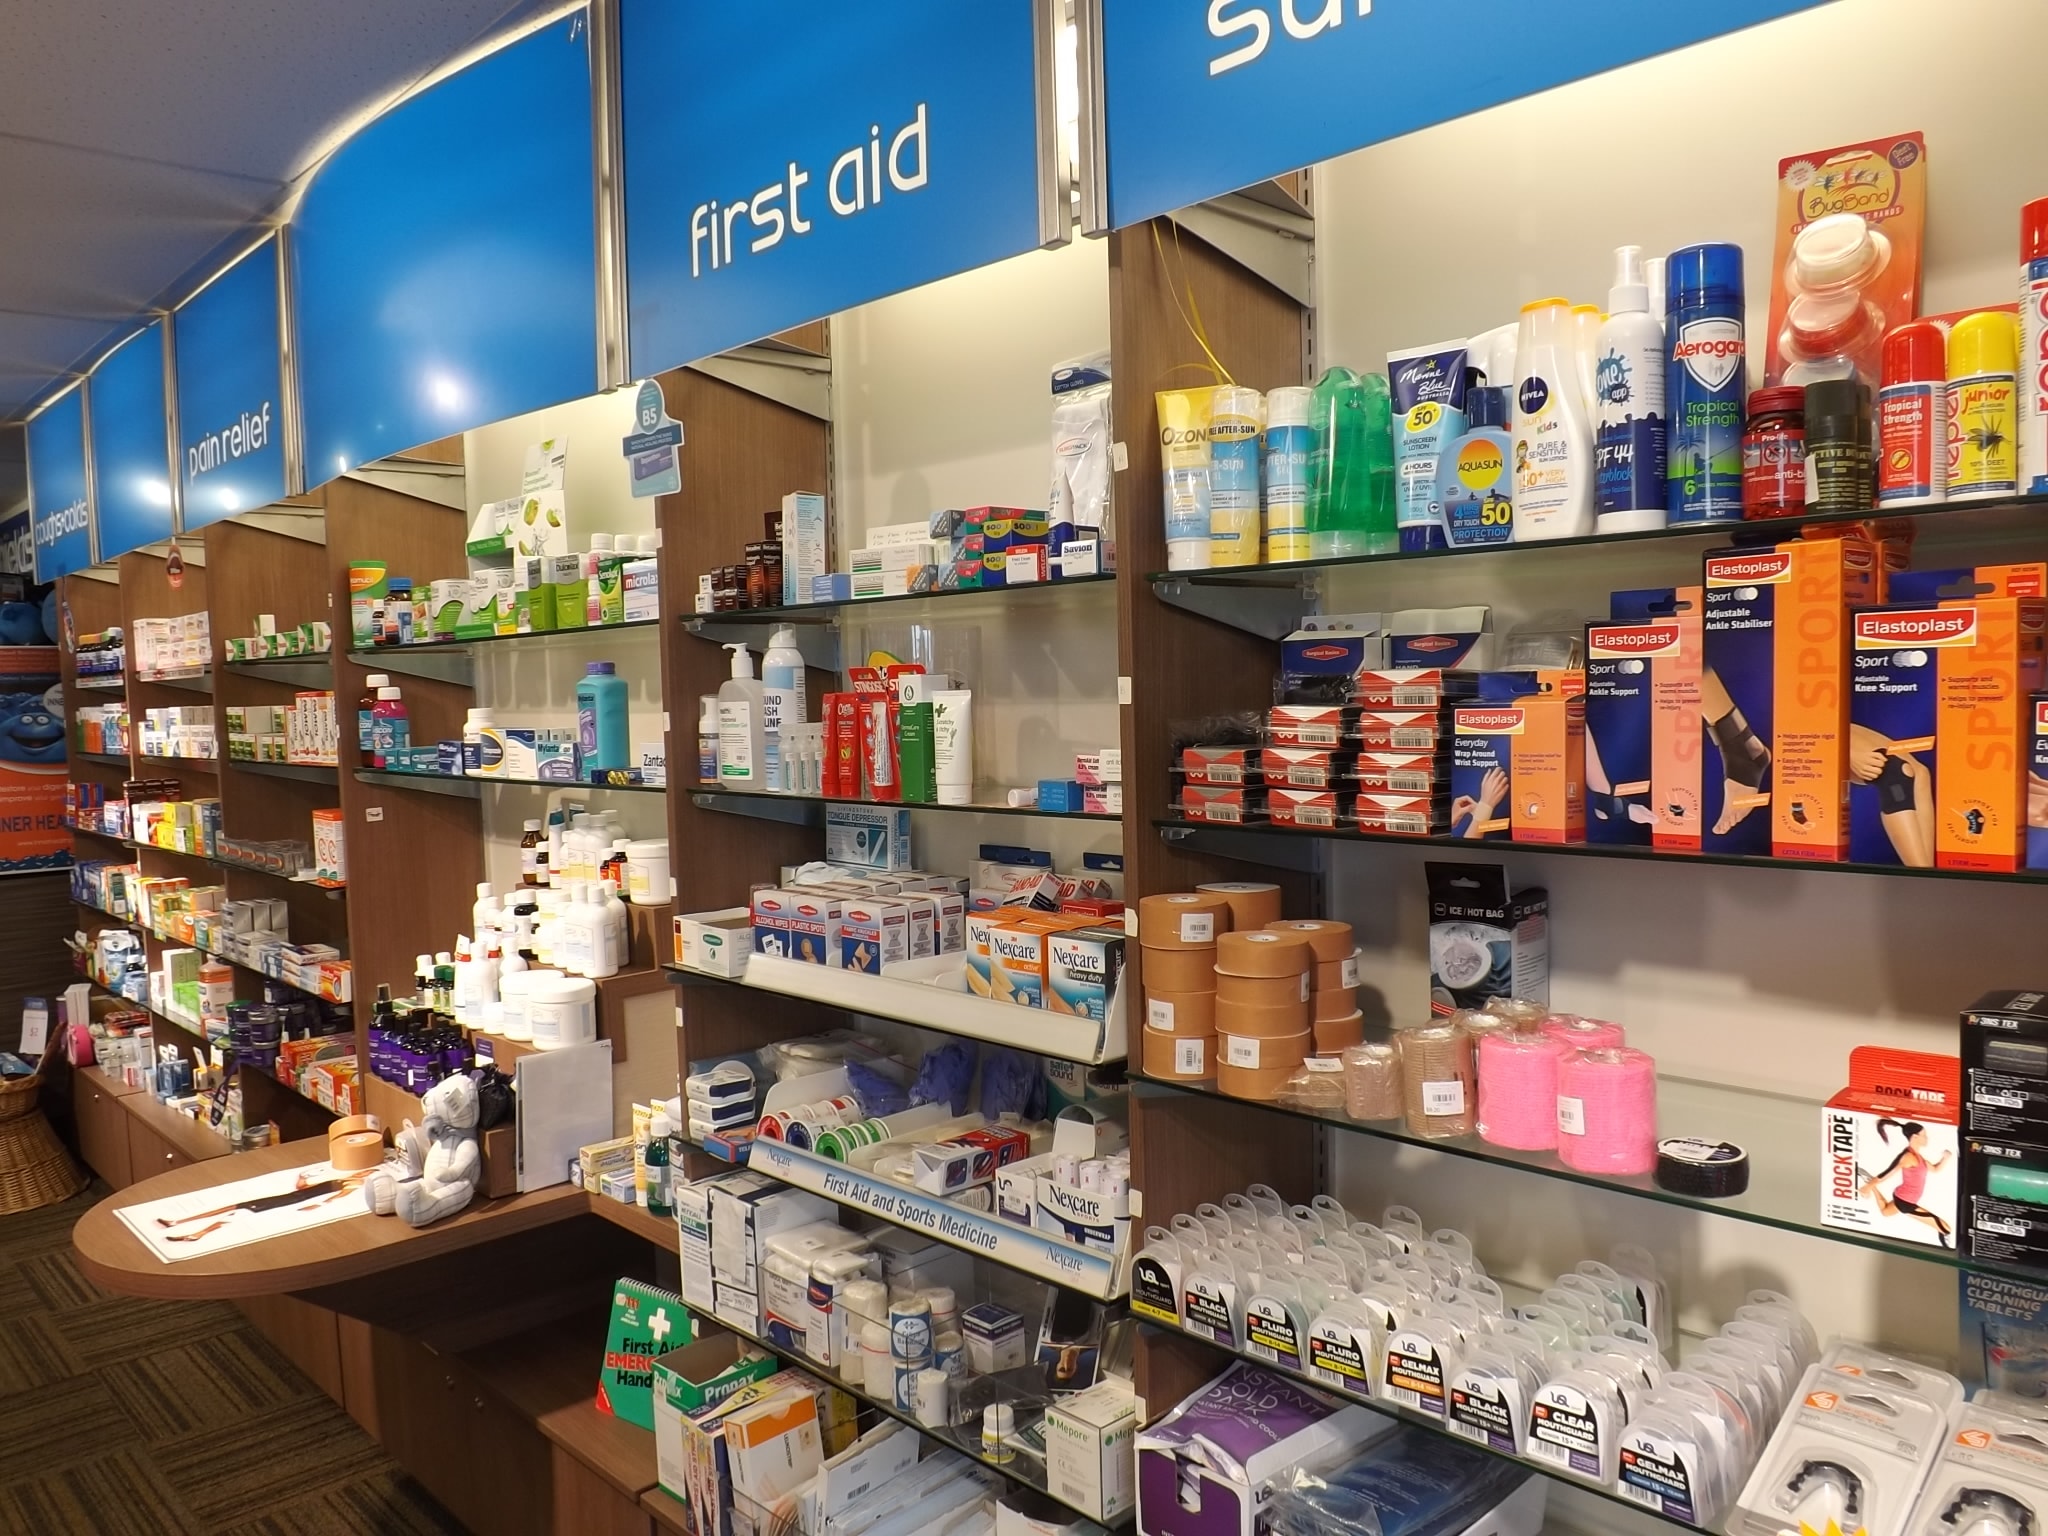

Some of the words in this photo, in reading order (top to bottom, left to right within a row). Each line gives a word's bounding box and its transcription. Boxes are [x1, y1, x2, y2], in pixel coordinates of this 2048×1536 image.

[690, 161, 811, 278] first
[828, 102, 929, 215] aid
[1400, 368, 1443, 383] Marine
[1418, 380, 1446, 394] Blue
[1611, 385, 1627, 399] app
[1417, 391, 1451, 401] AUSTRALIA
[1521, 390, 1545, 402] NIVEA
[1961, 384, 2010, 415] junior
[1687, 400, 1739, 414] Tropical
[1884, 398, 1922, 413] Tropical
[642, 408, 658, 426] B5
[1522, 416, 1542, 427] sun
[1686, 414, 1739, 427] Strength
[1883, 411, 1922, 426] Strength
[1217, 425, 1256, 435] AFTER-SUN
[1536, 422, 1558, 435] Kids
[189, 434, 220, 487] pain
[222, 400, 271, 462] relief
[1403, 437, 1437, 446] SUNSCREEN
[1408, 443, 1429, 451] LOTION
[1537, 441, 1558, 450] PURE
[1561, 439, 1567, 448] &
[1528, 448, 1567, 459] SENSITIVE
[1614, 444, 1634, 464] 44
[1411, 462, 1433, 470] HOURS
[1457, 459, 1503, 472] AQUASUN
[1987, 459, 2005, 467] DEET
[1544, 469, 1565, 477] VERY
[1545, 476, 1566, 485] HIGH
[1684, 479, 1697, 496] 6
[1454, 506, 1464, 519] 4
[1481, 502, 1511, 526] 50
[1453, 519, 1464, 527] DRY
[1464, 517, 1480, 526] TOUCH
[1453, 527, 1509, 539] PROTECTION
[1711, 560, 1783, 576] Elastoplast
[1706, 592, 1732, 604] Sport
[1705, 608, 1751, 619] Adjustable
[1705, 620, 1730, 630] Ankle
[1731, 619, 1773, 630] Stabiliser
[1797, 545, 1839, 709] SPORT
[1862, 618, 1965, 635] Elastoplast
[1595, 633, 1672, 647] Elastoplast
[1855, 656, 1889, 668] Sport
[1589, 664, 1616, 675] Sport
[1855, 675, 1890, 683] Adjustable
[1589, 687, 1609, 696] Ankle
[1610, 687, 1639, 697] Support
[1855, 684, 1877, 692] Knee
[1879, 683, 1918, 694] Support
[1458, 714, 1518, 726] Elastoplast
[1455, 738, 1489, 749] Everyday
[1454, 750, 1470, 760] Wrap
[1471, 750, 1495, 758] Around
[1454, 759, 1471, 767] Wrist
[1472, 759, 1498, 768] Support
[827, 811, 851, 821] TONGUE
[851, 813, 888, 824] DEPRESSOR
[1057, 882, 1076, 898] AID
[1449, 906, 1463, 916] ICE
[1467, 908, 1484, 918] HOT
[1485, 909, 1505, 919] BAG
[754, 916, 775, 926] ALCOHOL
[775, 919, 789, 929] WIPES
[791, 920, 809, 932] PLASTIC
[810, 923, 826, 934] SPOTS
[994, 937, 1036, 961] Nexcare
[1053, 946, 1099, 971] Nexcare
[1023, 964, 1040, 973] active
[1069, 970, 1088, 981] heavy
[1088, 974, 1103, 983] duty
[1049, 1071, 1074, 1082] sound
[766, 1147, 793, 1168] Nexcare
[1049, 1183, 1100, 1218] Nexcare
[823, 1172, 850, 1197] First
[850, 1182, 871, 1204] Aid
[872, 1190, 894, 1213] and
[896, 1201, 936, 1229] Sports
[938, 1213, 998, 1251] Medicine
[1045, 1246, 1084, 1271] Nexcare
[1135, 1288, 1173, 1305] MOUTHGUARD
[1966, 1286, 2041, 1312] CLEANING
[1190, 1303, 1228, 1322] MOUTHGUARD
[1199, 1298, 1227, 1315] BLACK
[1967, 1298, 2034, 1321] TABLETS
[1251, 1325, 1295, 1345] MOUTHGUARD
[1261, 1319, 1294, 1338] FLURO
[622, 1337, 654, 1353] First
[1326, 1343, 1360, 1361] FLURO
[1314, 1349, 1362, 1369] MOUTHGUARD
[1401, 1358, 1440, 1376] GELMAX
[616, 1369, 653, 1388] Hand
[1391, 1365, 1440, 1384] MOUTHGUARD
[1455, 1402, 1509, 1426] MOUTHGUARD
[1469, 1397, 1508, 1418] BLACK
[1537, 1417, 1595, 1441] MOUTHGUARD
[1552, 1411, 1595, 1433] CLEAR
[1055, 1418, 1089, 1443] Mepore
[1561, 1436, 1575, 1445] 15+
[1625, 1462, 1687, 1490] MOUTHGUARD
[1636, 1457, 1686, 1482] GELMAX
